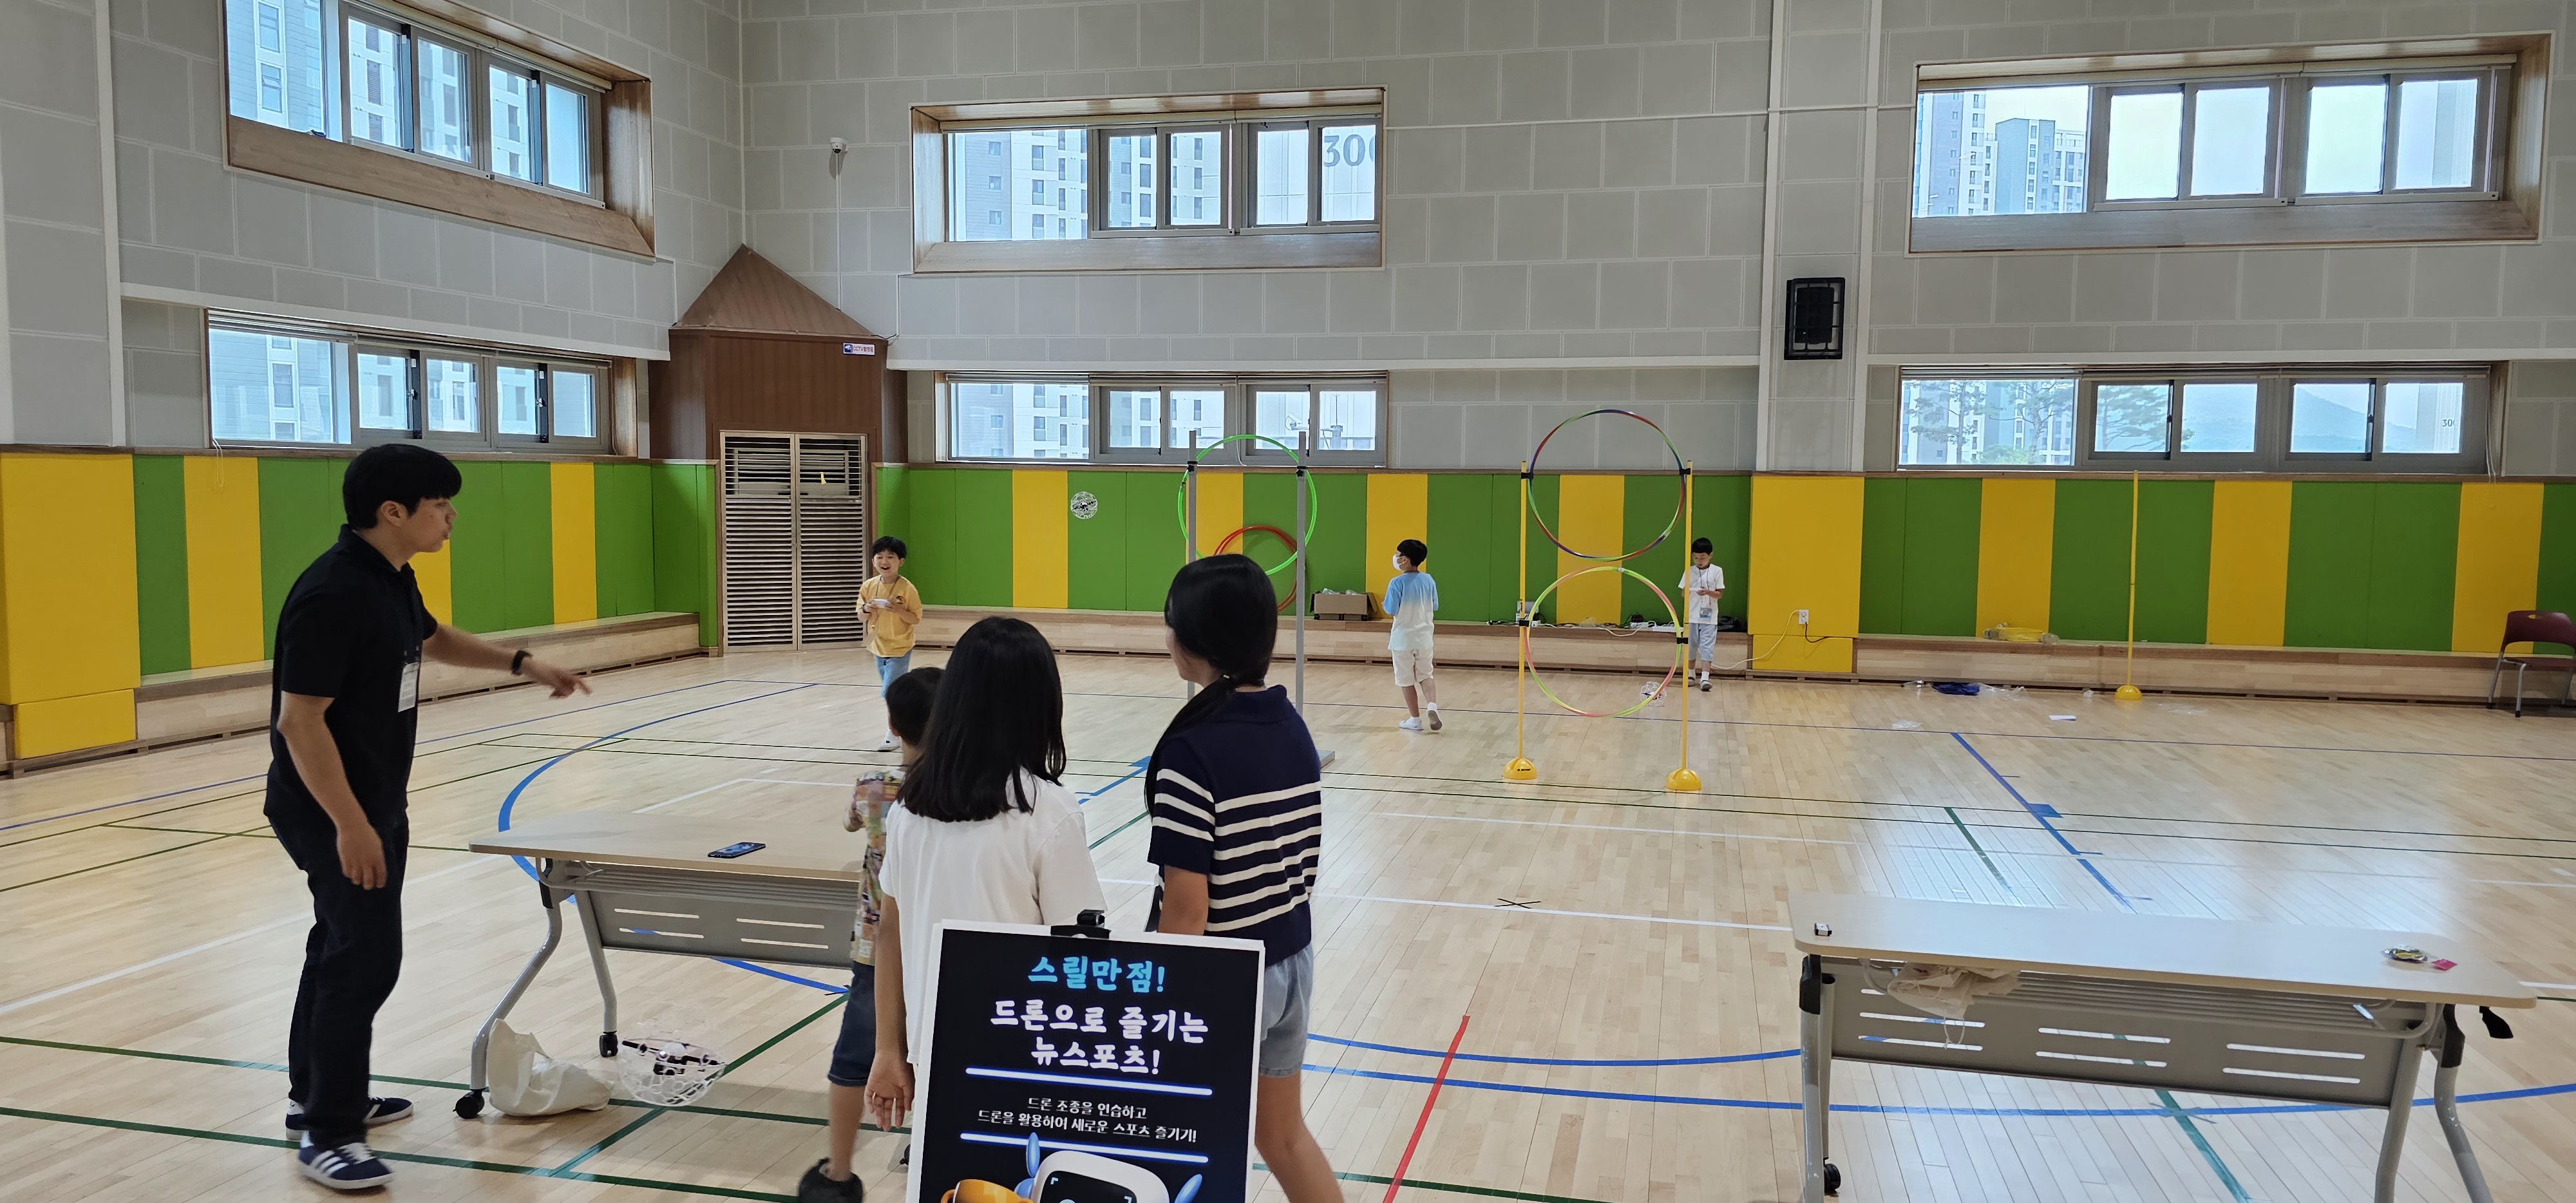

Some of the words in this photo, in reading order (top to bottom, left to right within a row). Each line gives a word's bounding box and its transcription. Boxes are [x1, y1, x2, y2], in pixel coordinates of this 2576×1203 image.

[990, 999, 1107, 1033] 드론으로
[1119, 1007, 1209, 1043] 즐기는
[1031, 1036, 1160, 1075] 뉴스포츠!
[1028, 1097, 1052, 1112] 드론
[1056, 1100, 1094, 1115] 조종을
[1097, 1103, 1147, 1119] 연습하고
[978, 1110, 1014, 1125] 드론을
[1018, 1113, 1068, 1130] 활용하여
[1071, 1118, 1109, 1134] 새로운
[1113, 1123, 1151, 1138] 스포츠
[1155, 1126, 1197, 1143] 즐기기!
